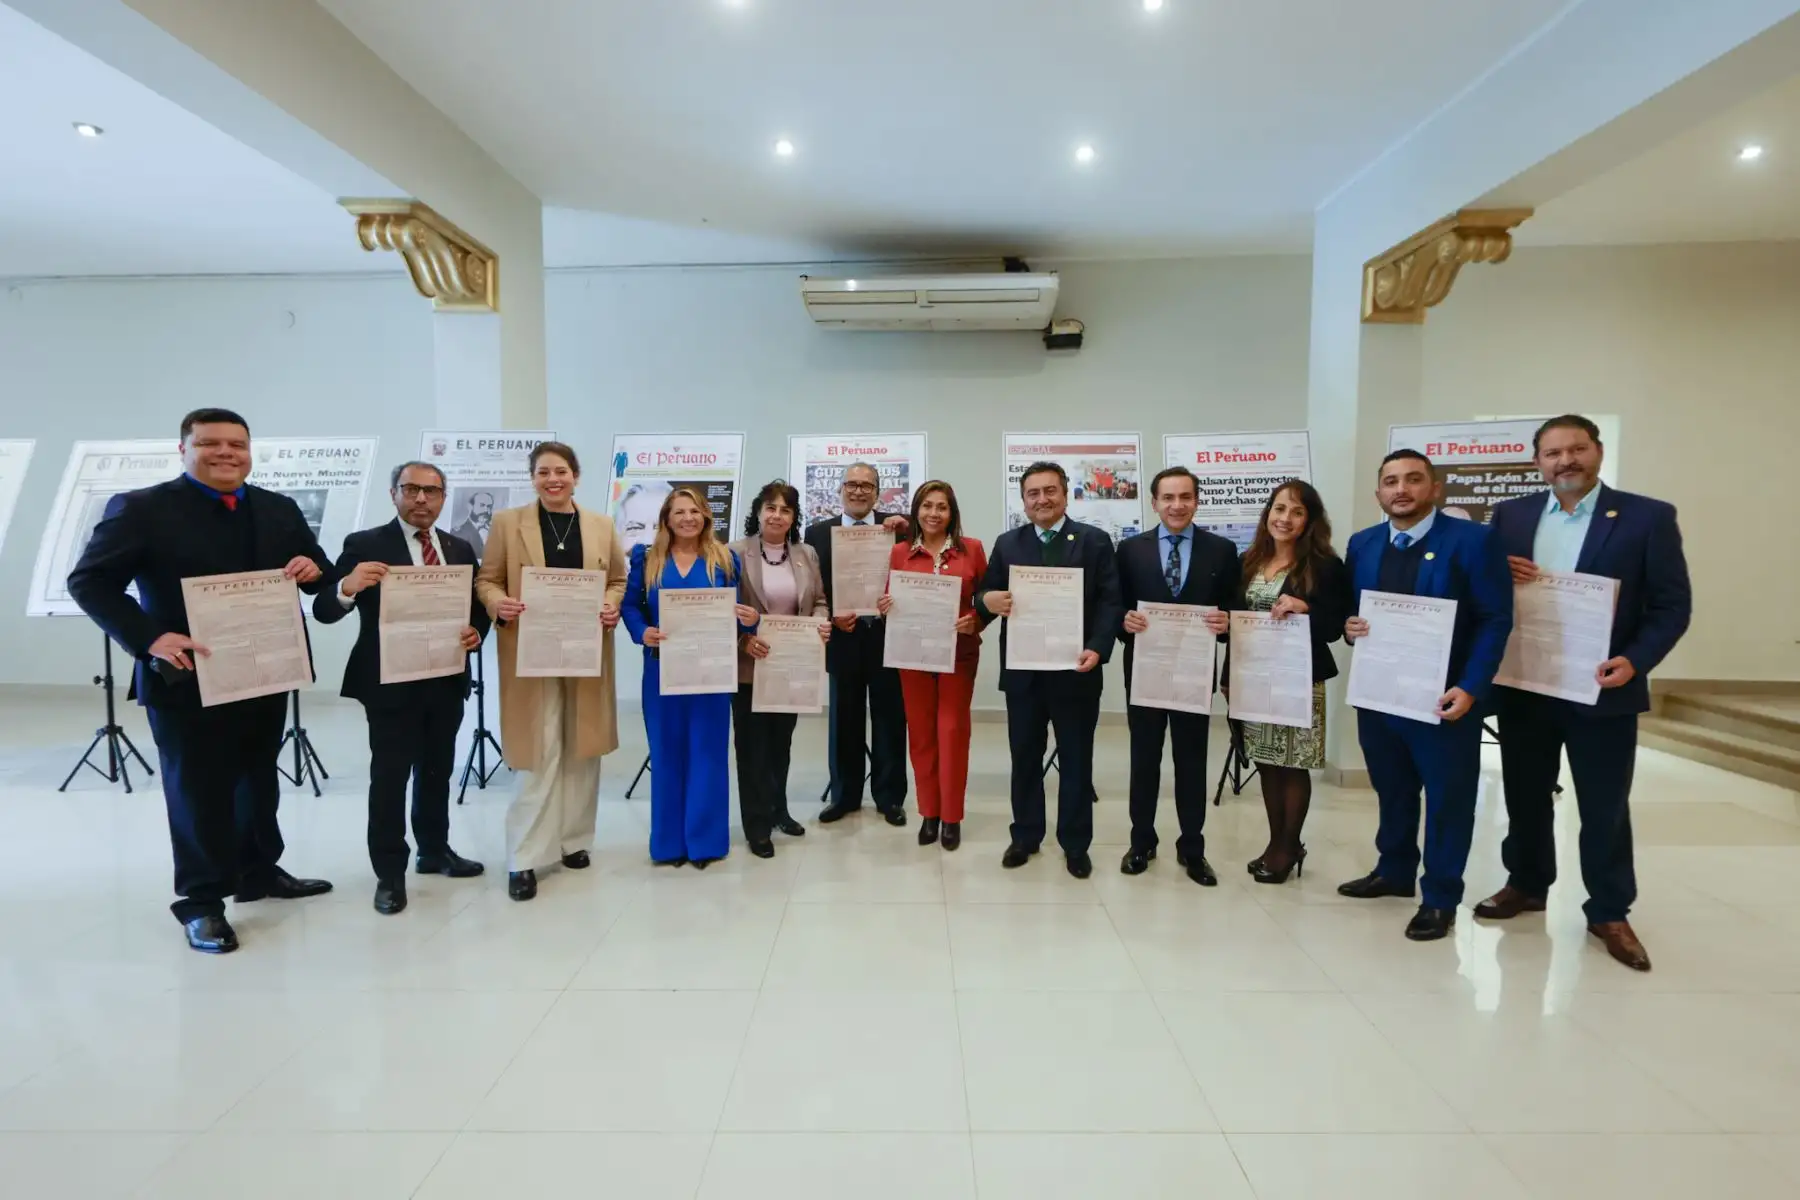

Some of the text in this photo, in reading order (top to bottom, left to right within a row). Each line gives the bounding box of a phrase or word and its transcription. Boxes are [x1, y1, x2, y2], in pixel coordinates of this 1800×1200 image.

[456, 439, 473, 450] EL
[1425, 442, 1525, 456] El Peruano
[278, 448, 361, 459] EL PERUANO
[827, 446, 888, 456] El Peruano
[636, 451, 717, 466] El Peruano
[1196, 451, 1277, 464] El Peruano
[252, 469, 362, 479] Un Nuevo Mundo
[1446, 473, 1483, 486] Papa
[1485, 471, 1522, 484] León
[304, 479, 360, 487] Hombre
[1473, 485, 1490, 494] es
[1492, 483, 1506, 494] el
[1198, 486, 1270, 497] Puno y Cusco
[1211, 496, 1257, 506] brechas
[1445, 496, 1486, 505] sumo
